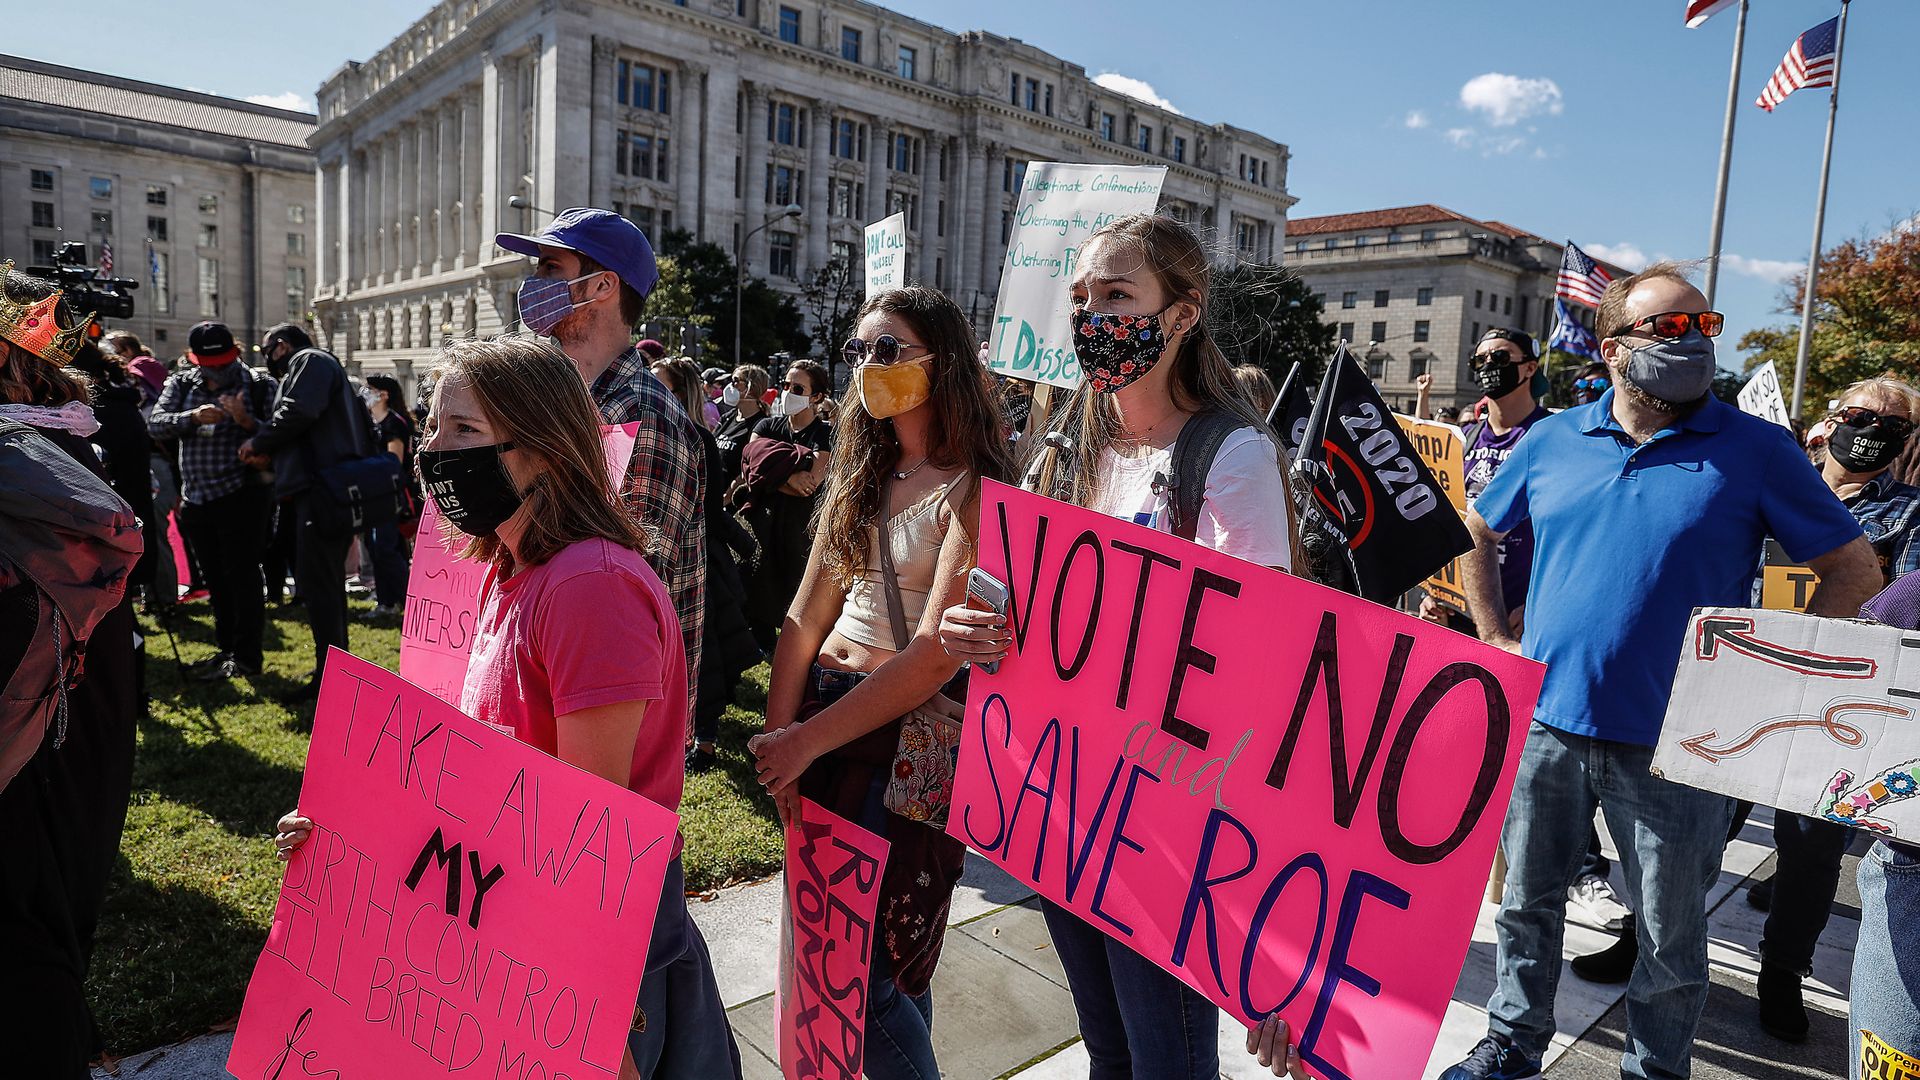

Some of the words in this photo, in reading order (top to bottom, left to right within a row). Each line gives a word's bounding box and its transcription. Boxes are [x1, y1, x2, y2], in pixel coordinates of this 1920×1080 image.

[1027, 170, 1084, 202] Illegitimate
[1091, 175, 1158, 195] Confirmations
[886, 233, 903, 248] CALL
[1019, 204, 1069, 236] Overturning
[1072, 212, 1089, 230] the
[1011, 242, 1061, 278] Overturning
[990, 315, 1013, 368] I
[1012, 319, 1080, 381] Disse
[1762, 370, 1776, 398] SO
[1339, 402, 1437, 521] 2020
[1851, 444, 1866, 454] ON
[1867, 448, 1880, 457] US
[1853, 436, 1887, 449] COUNT
[438, 495, 460, 509] US
[996, 501, 1242, 752] VOTE
[1265, 610, 1512, 865] NO
[339, 668, 485, 824] TAKE
[485, 767, 665, 919] AWAY
[1123, 720, 1254, 811] and
[404, 825, 506, 930] MY
[964, 693, 1161, 938] SAVE
[1170, 807, 1412, 1080] ROE
[364, 957, 485, 1072] BREED
[405, 902, 618, 1076] CONTROL
